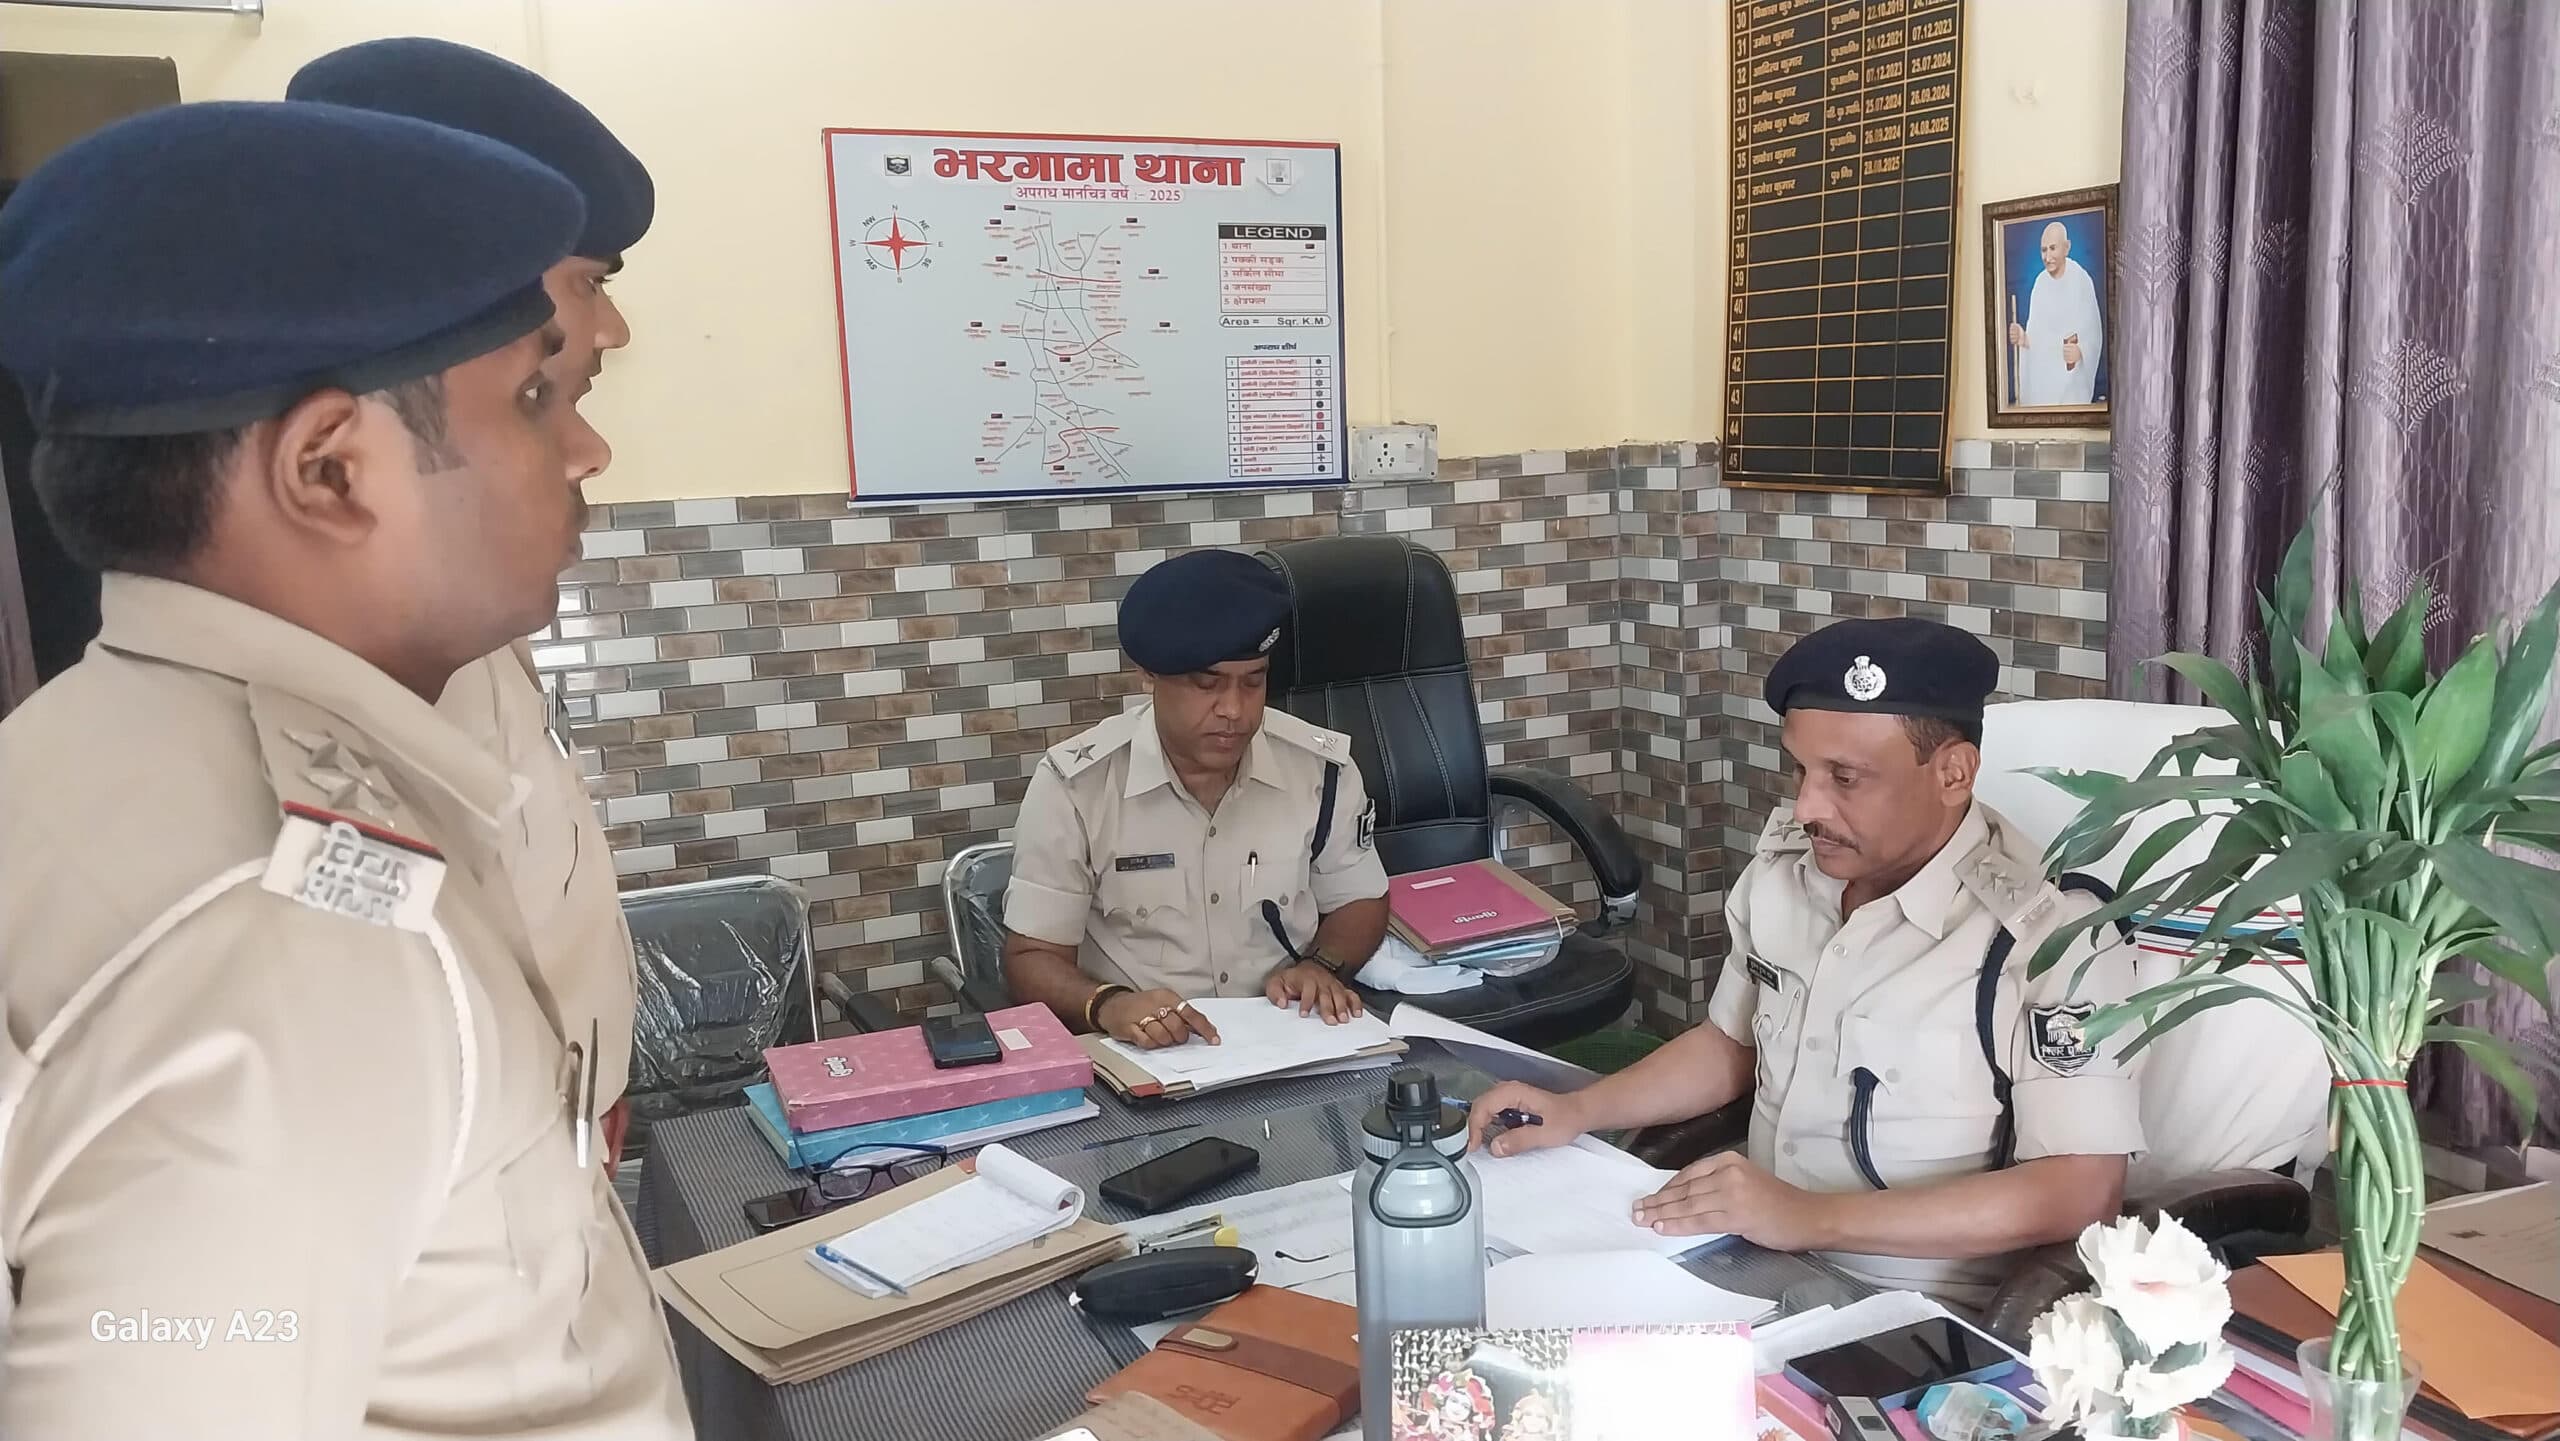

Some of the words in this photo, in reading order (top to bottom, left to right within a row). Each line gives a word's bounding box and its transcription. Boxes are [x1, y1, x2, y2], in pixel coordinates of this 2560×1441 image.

[1736, 11, 1746, 29] 30
[1737, 38, 1746, 57] 31
[1737, 67, 1746, 84] 32
[1867, 30, 1903, 52] 24.12.2021
[1912, 18, 1952, 41] 07.12.2023
[1737, 97, 1746, 114] 33
[1866, 61, 1903, 83] 07.12.2023
[1912, 51, 1952, 73] 25.07.2024
[1737, 125, 1747, 142] 34
[1911, 84, 1951, 105] 26.09.2024
[933, 148, 1124, 182] भरगामा
[1134, 154, 1245, 186] थाना
[1737, 152, 1746, 169] 35
[1017, 186, 1057, 199] अपराध
[1062, 186, 1106, 200] मानचित्र
[1150, 189, 1181, 201] 2025
[1737, 183, 1746, 200] 36
[862, 216, 876, 228] NW
[918, 219, 930, 231] NE
[1736, 214, 1745, 232] 37
[1234, 226, 1312, 239] LEGEND
[1735, 242, 1745, 259] 38
[864, 258, 878, 271] SW
[922, 257, 932, 269] SE
[1734, 270, 1744, 287] 39
[1734, 298, 1744, 314] 40
[1222, 318, 1250, 326] Area
[1277, 317, 1299, 327] Sqr.
[1732, 327, 1742, 343] 41
[1731, 356, 1741, 373] 42
[1730, 389, 1740, 405] 43
[1729, 420, 1739, 437] 44
[1728, 452, 1738, 468] 45
